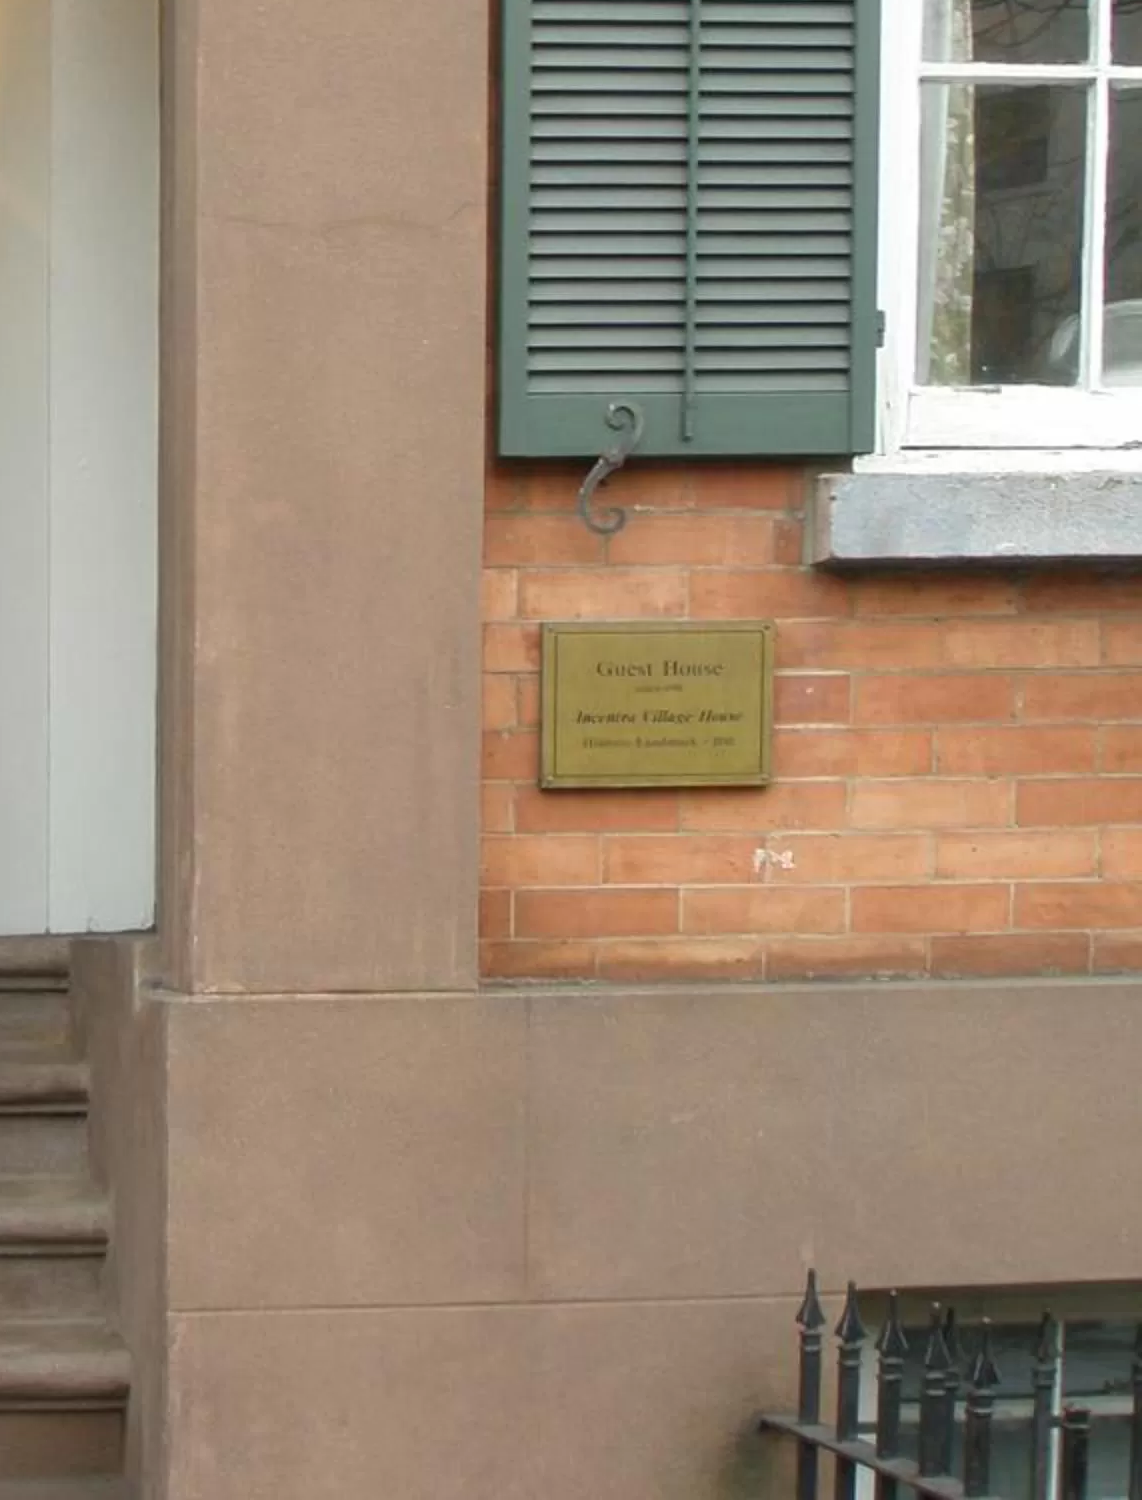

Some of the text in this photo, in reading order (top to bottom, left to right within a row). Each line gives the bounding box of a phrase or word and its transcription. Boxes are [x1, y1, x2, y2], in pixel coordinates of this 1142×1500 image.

[596, 660, 724, 677] Guest House
[643, 709, 692, 724] Village
